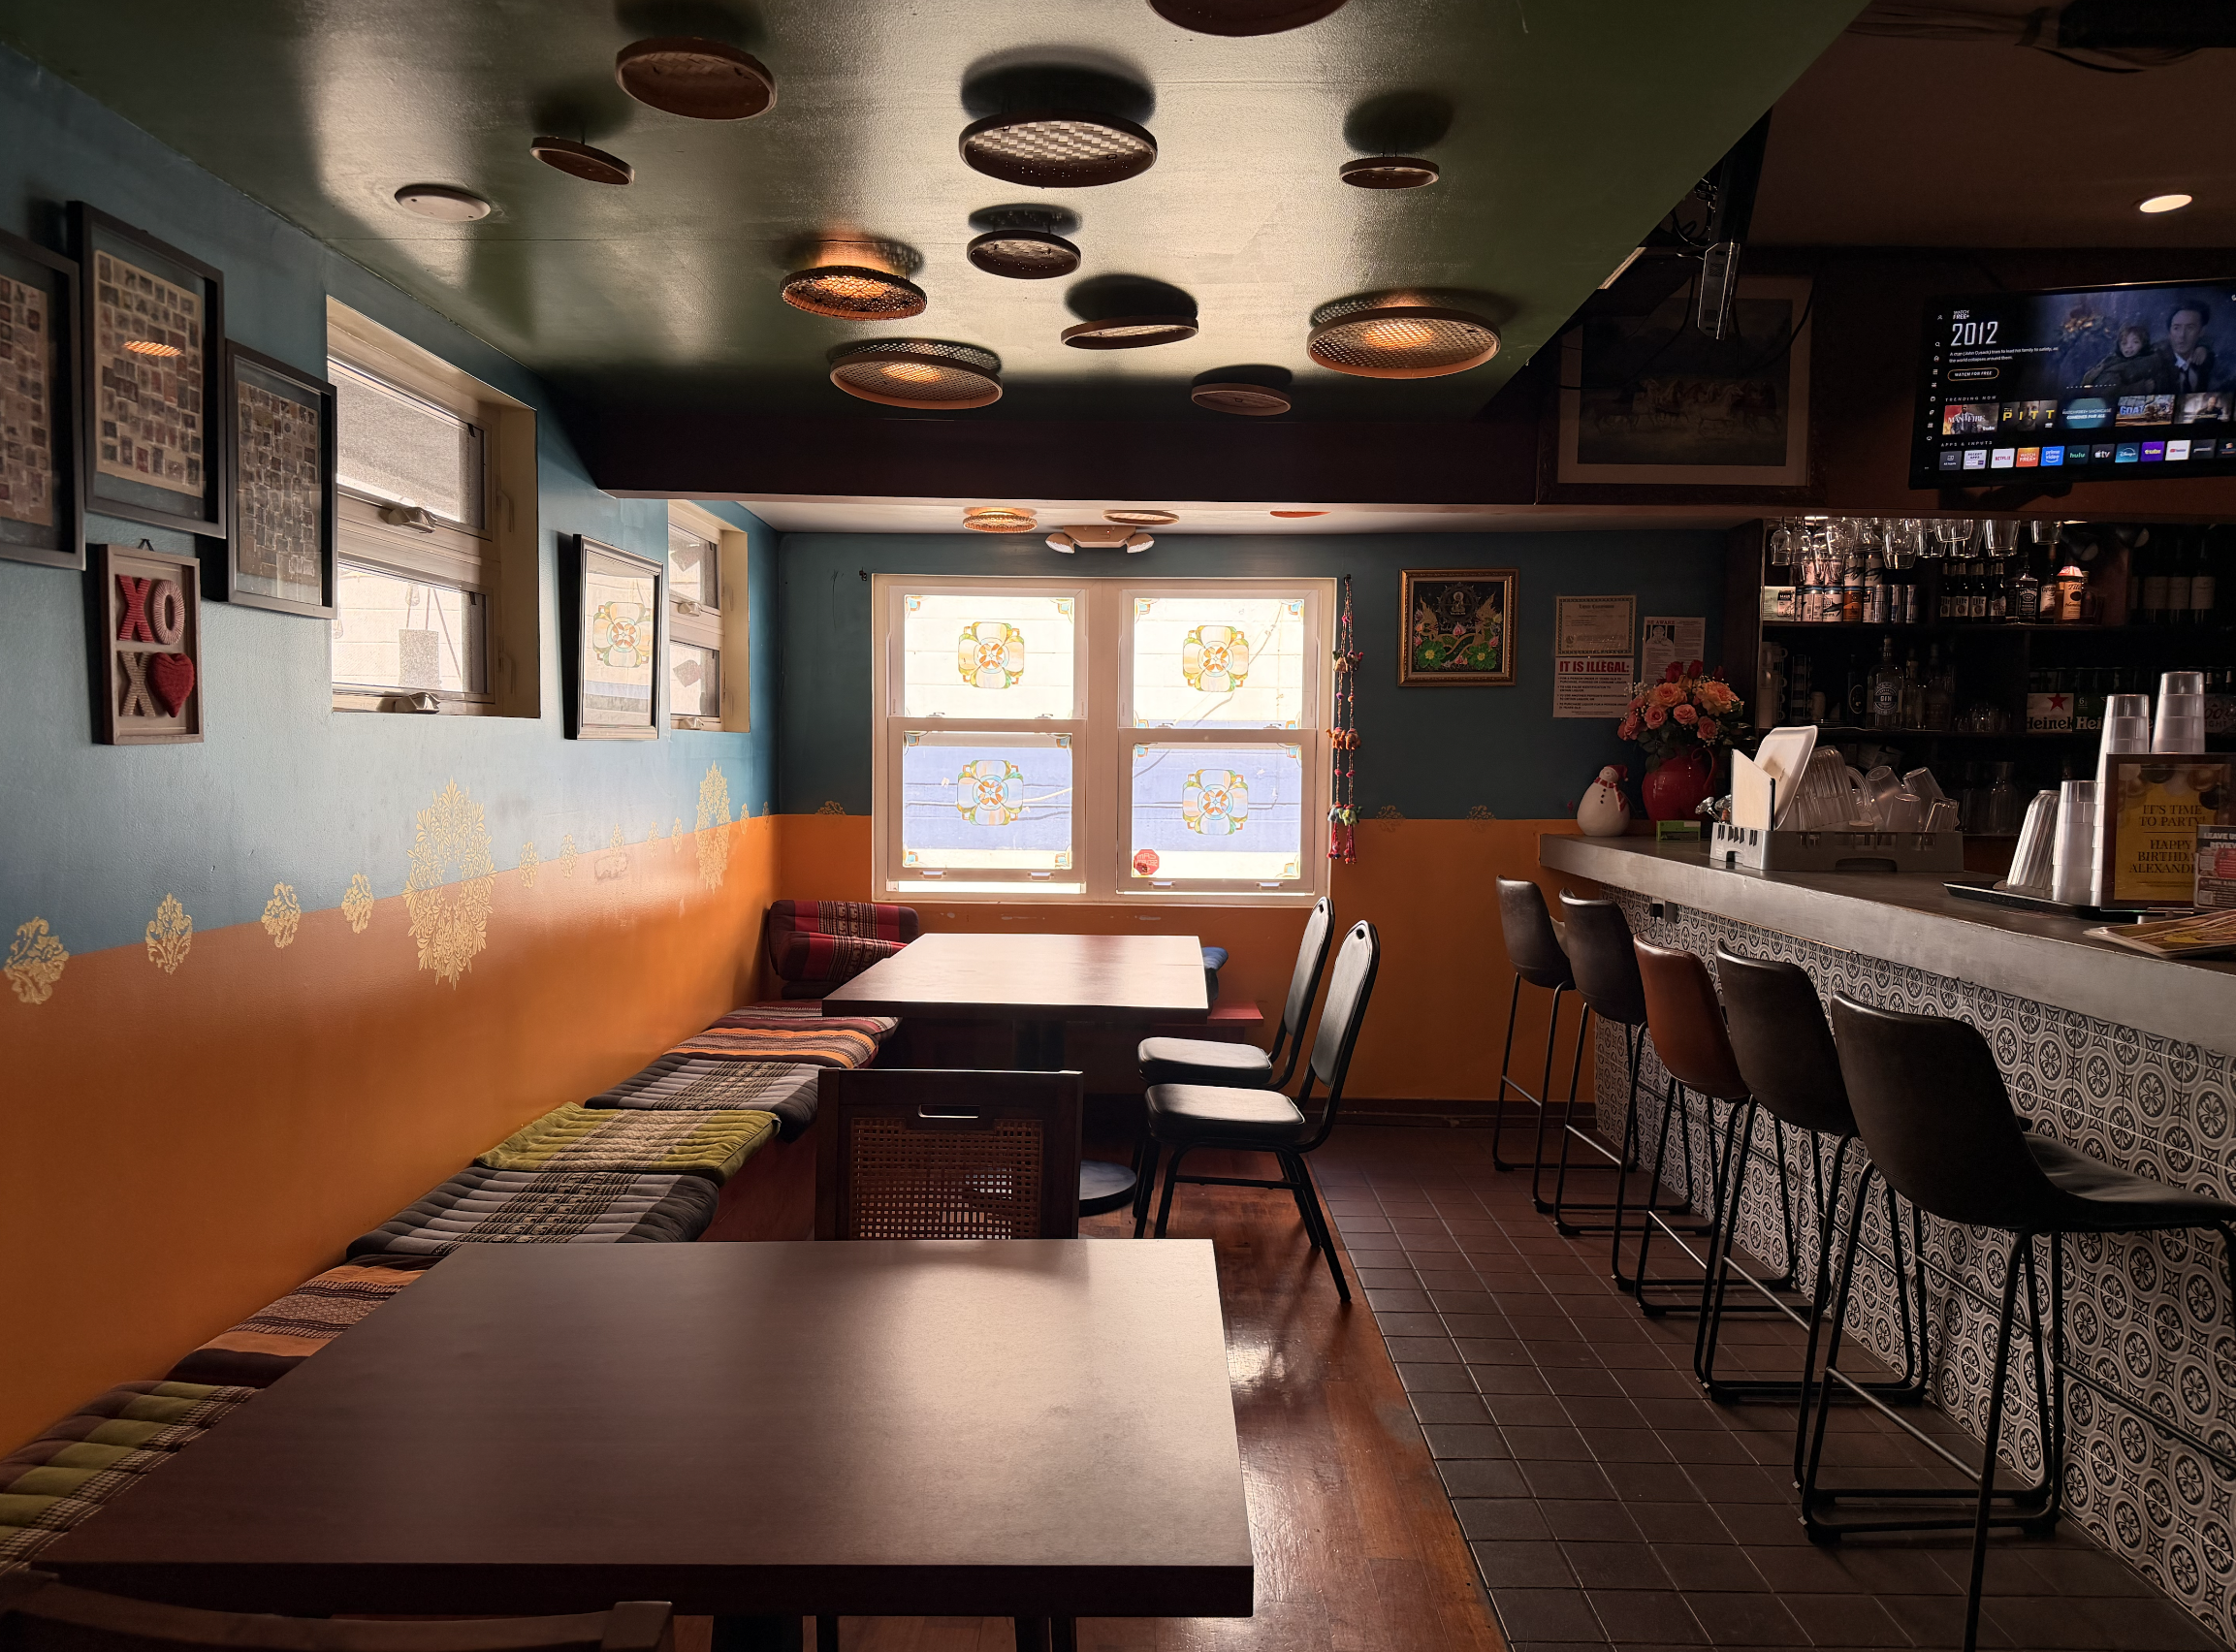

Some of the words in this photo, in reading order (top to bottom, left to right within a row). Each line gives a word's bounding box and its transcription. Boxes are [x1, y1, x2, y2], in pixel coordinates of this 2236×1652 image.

[1950, 321, 1999, 347] 2012
[2119, 405, 2144, 415] GOAT
[1560, 661, 1570, 672] IT
[1573, 661, 1584, 672] IS
[1586, 661, 1629, 673] ILLEGAL:
[2143, 805, 2166, 815] IT'S
[2170, 805, 2203, 815] TIME
[2140, 817, 2156, 826] TO
[2150, 840, 2193, 849] HAPPY
[2138, 852, 2195, 861] BIRTHDA
[2129, 864, 2194, 873] ALEXAND
